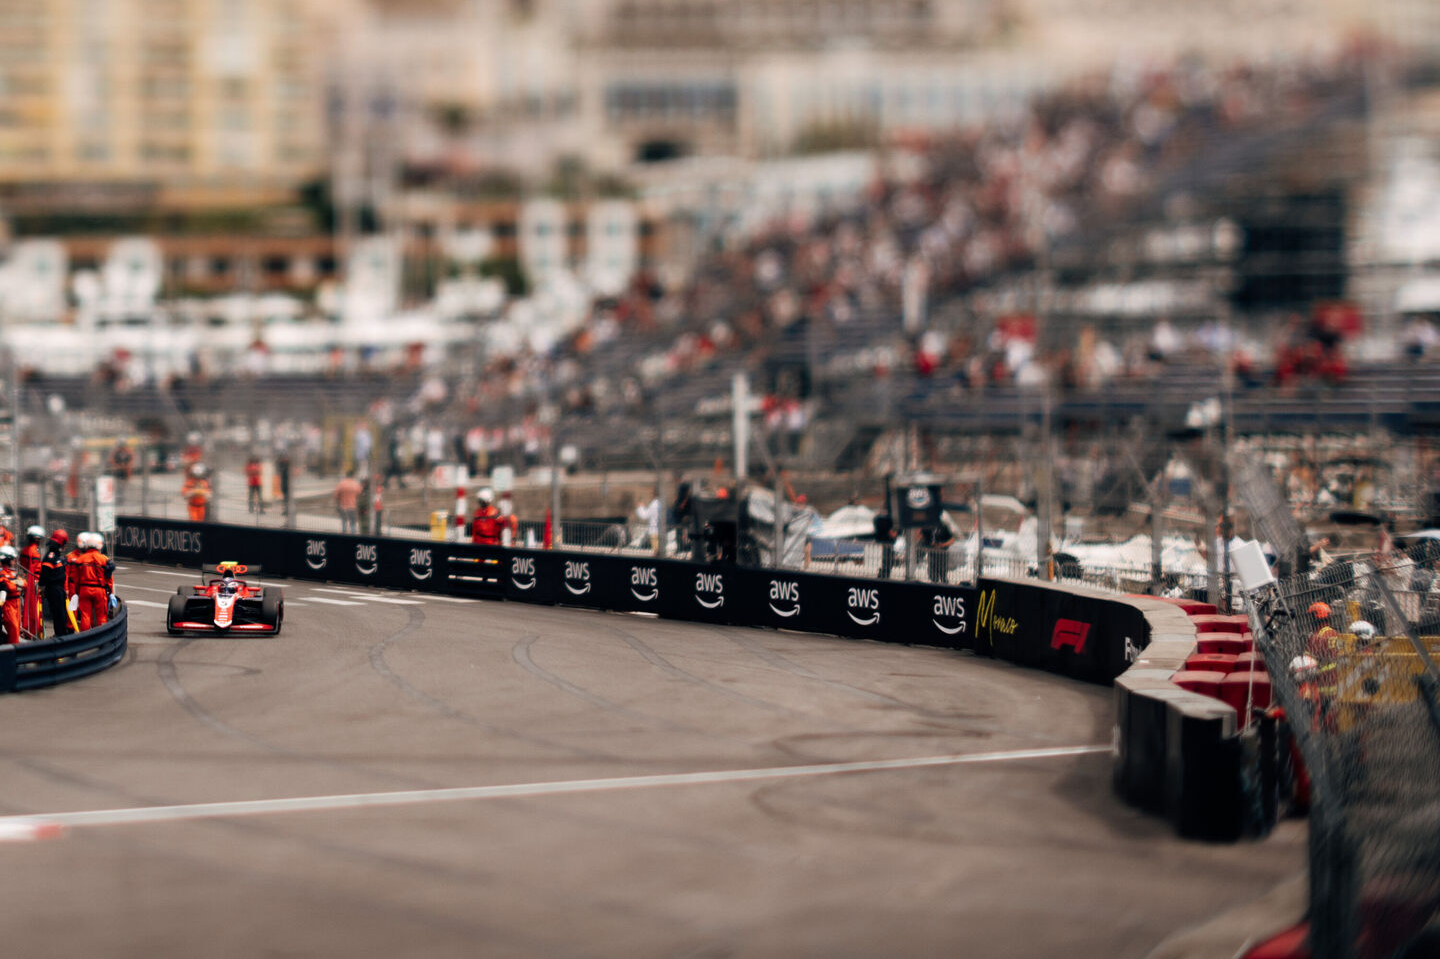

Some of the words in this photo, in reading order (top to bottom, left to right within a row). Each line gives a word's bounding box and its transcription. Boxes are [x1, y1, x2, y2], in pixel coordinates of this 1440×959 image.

[112, 526, 147, 549] PLORA
[150, 528, 201, 554] JOURNEYS
[306, 540, 326, 557] aws
[356, 544, 377, 562] aws
[410, 548, 432, 567] aws
[512, 556, 535, 575] aws
[565, 561, 590, 581] aws
[631, 566, 658, 587] aws
[696, 572, 723, 593] aws
[770, 580, 799, 602] aws
[848, 587, 879, 610] aws
[934, 594, 965, 618] aws
